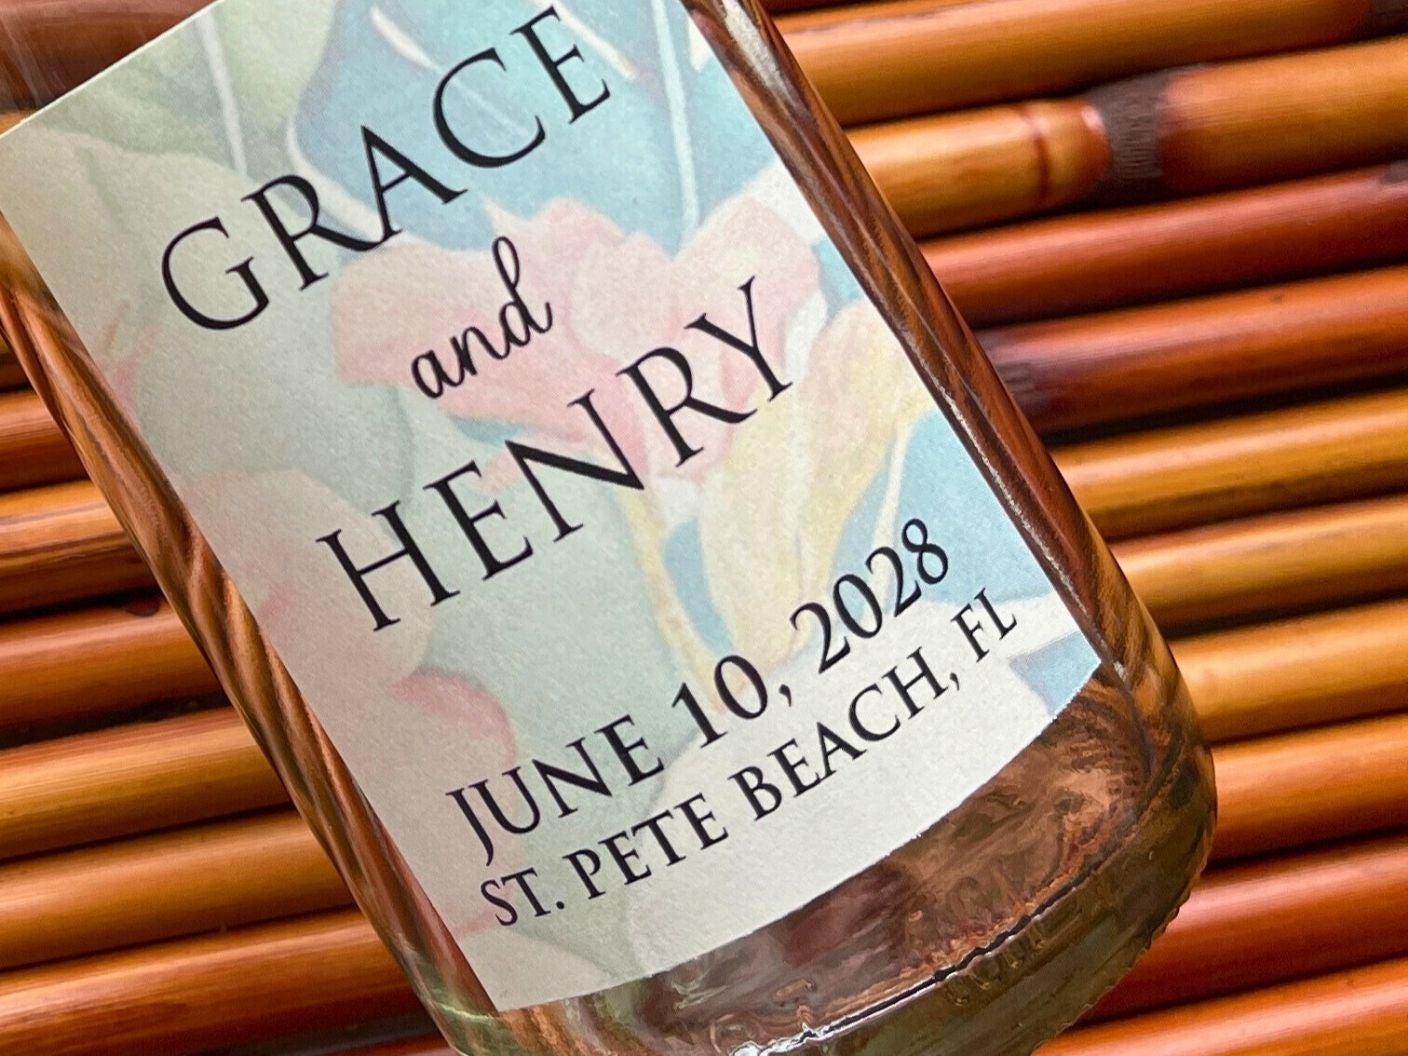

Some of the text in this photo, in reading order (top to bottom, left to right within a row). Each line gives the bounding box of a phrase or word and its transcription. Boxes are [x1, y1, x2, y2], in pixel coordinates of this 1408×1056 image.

[160, 5, 612, 332] GRACE
[410, 235, 554, 400] and
[314, 275, 794, 633] HENRY
[444, 517, 950, 868] JUNE 10, 2028
[479, 586, 1019, 928] ST. PETE BEACH, FL
